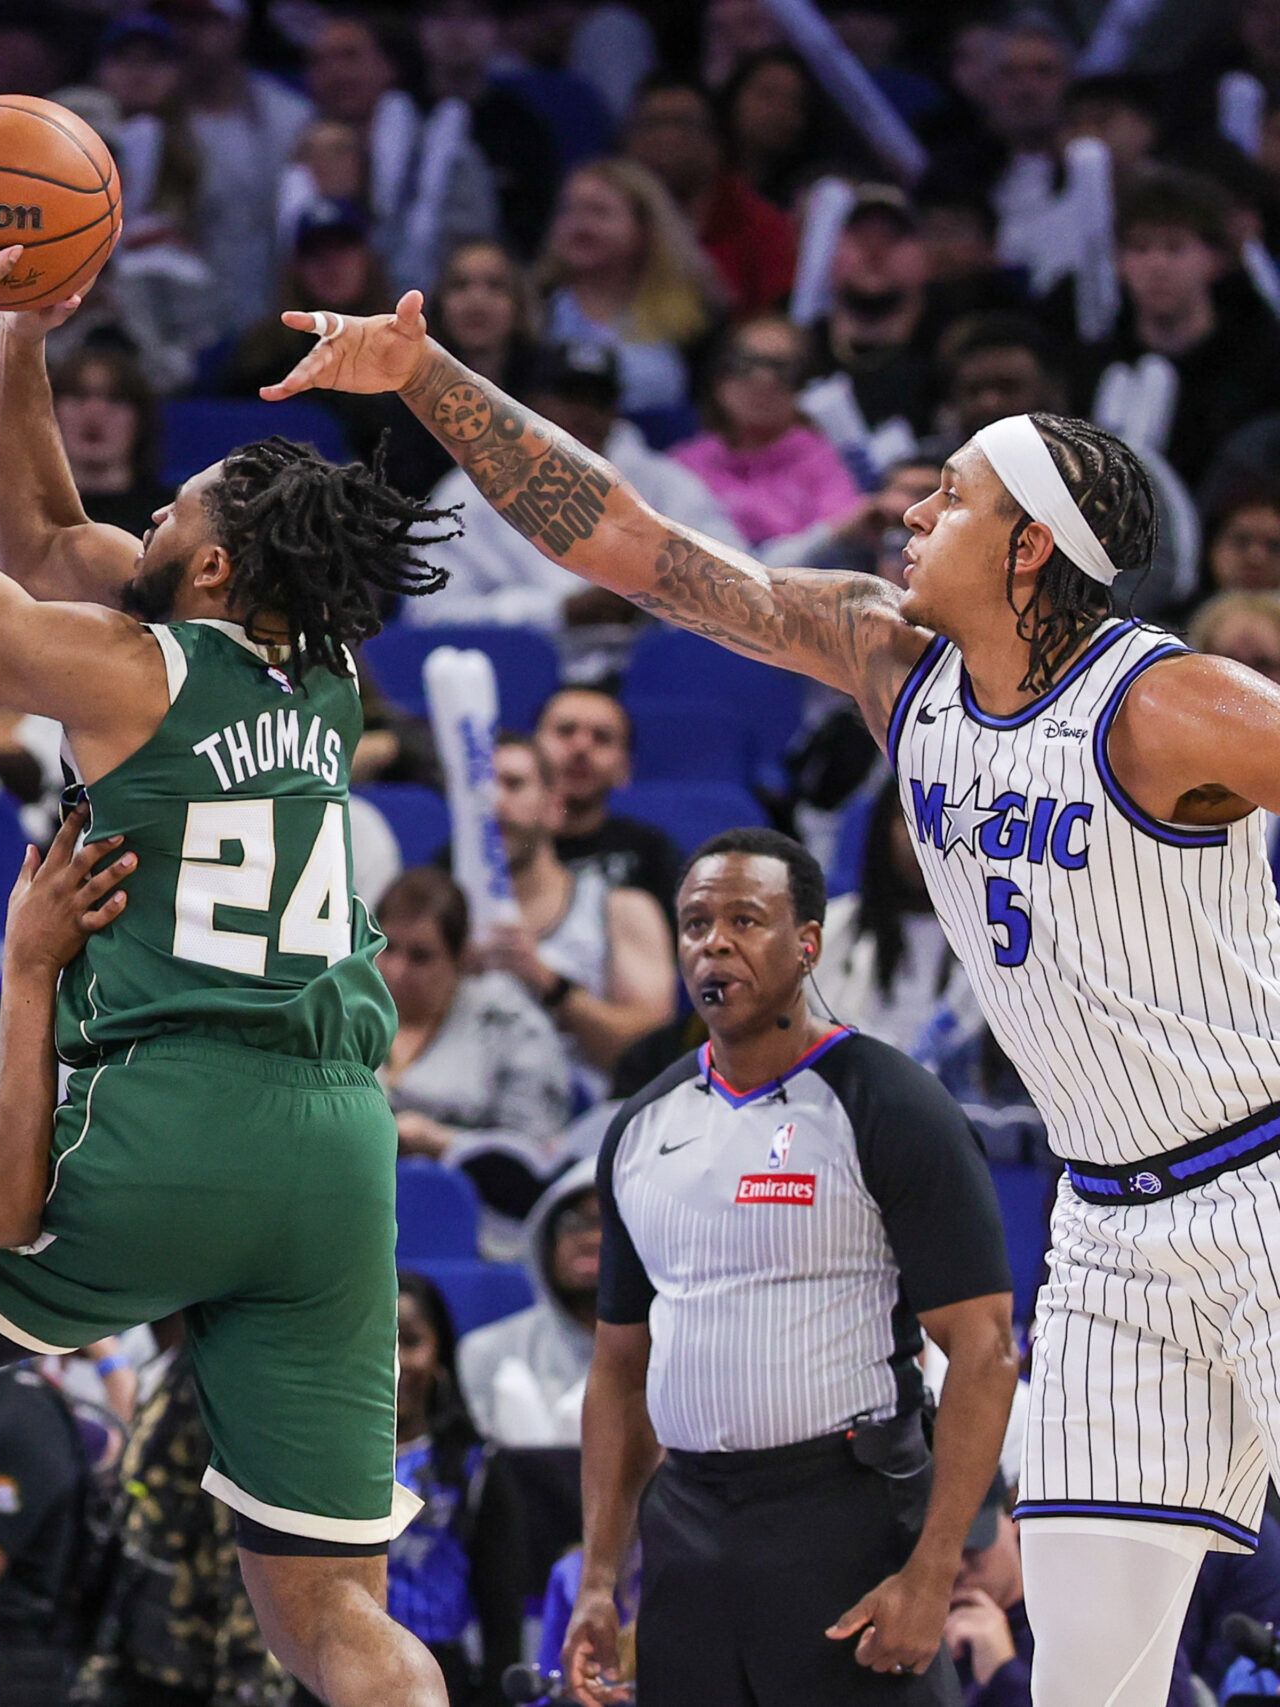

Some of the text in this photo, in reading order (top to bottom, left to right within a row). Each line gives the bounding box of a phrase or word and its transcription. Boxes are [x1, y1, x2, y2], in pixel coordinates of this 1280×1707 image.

[192, 708, 341, 792] THOMAS
[1042, 717, 1089, 746] Disney
[172, 799, 352, 977] 24
[985, 875, 1032, 968] 5
[738, 1178, 813, 1199] Emirates
